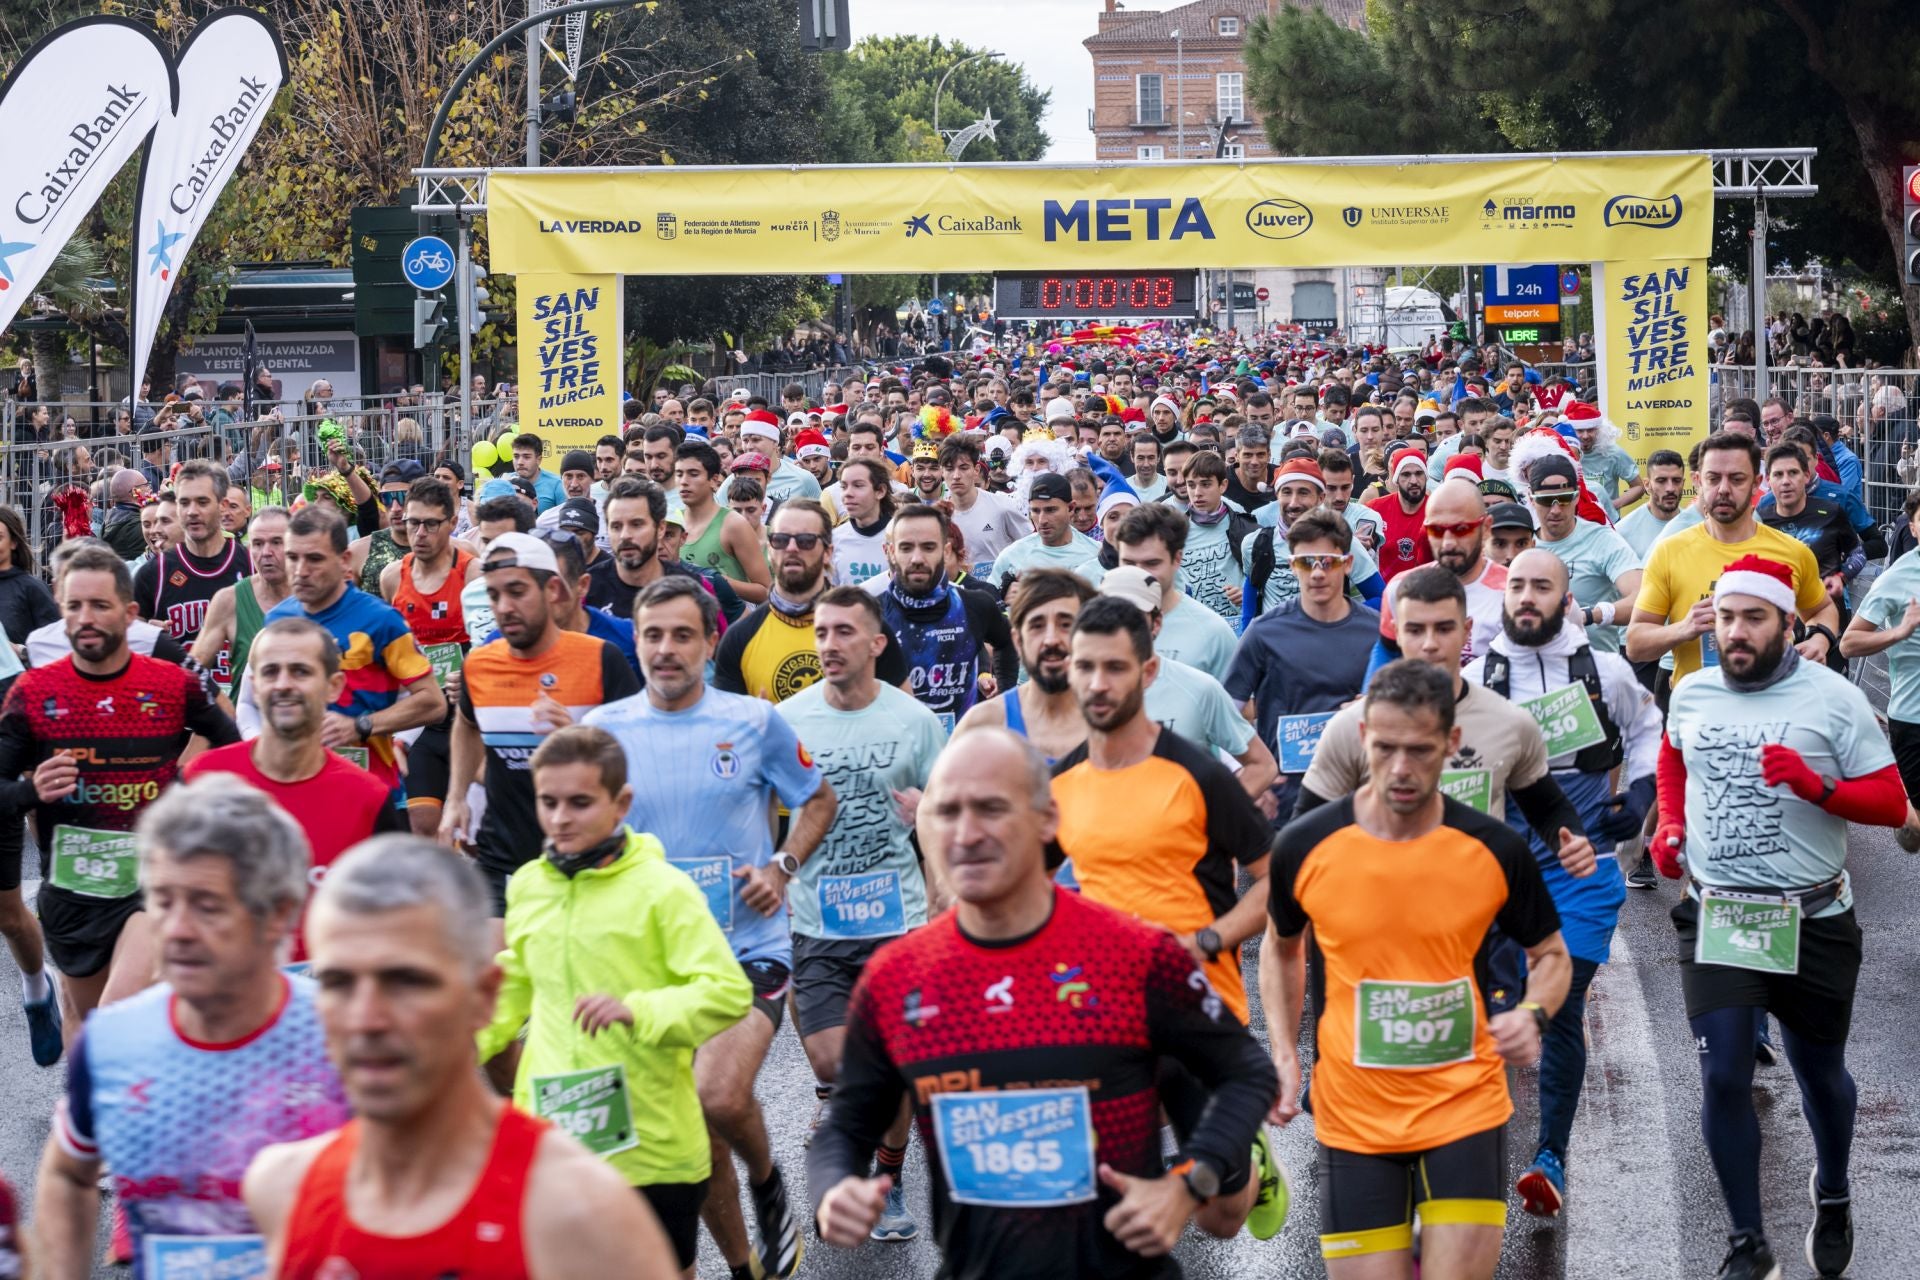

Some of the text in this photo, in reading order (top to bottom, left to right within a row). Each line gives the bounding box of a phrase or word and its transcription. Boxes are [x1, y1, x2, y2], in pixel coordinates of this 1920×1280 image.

[15, 83, 141, 224] CaixaBank
[170, 75, 267, 215] CaixaBank
[938, 215, 1022, 231] CaixaBank
[1044, 197, 1216, 242] META
[1253, 212, 1306, 227] Juver
[1371, 206, 1449, 218] UNIVERSAE
[1400, 218, 1428, 226] Superior
[1503, 205, 1575, 220] marmo
[1615, 205, 1672, 220] VIDAL
[540, 220, 641, 233] LA VERDAD
[701, 228, 723, 236] Región
[844, 220, 893, 228] Ayuntamiento
[1043, 277, 1173, 308] 0:00:08
[1516, 284, 1542, 296] 24h
[1622, 266, 1689, 301] SAN
[533, 287, 600, 321] SAN
[1503, 309, 1540, 319] telpark
[1632, 293, 1680, 325] SIL
[544, 314, 590, 344] SIL
[1505, 330, 1538, 341] LIBRE
[1625, 315, 1688, 349] VES
[275, 345, 336, 355] AVANZADA
[538, 335, 598, 368] VES
[1626, 342, 1690, 375] TRE
[204, 360, 211, 369] Y
[268, 359, 312, 369] DENTAL
[538, 361, 600, 393] TRE
[1627, 365, 1694, 391] MURCIA
[539, 384, 605, 409] MURCIA
[1627, 399, 1692, 409] LA VERDAD
[538, 418, 603, 427] LA VERDAD
[850, 562, 882, 577] SAN
[426, 645, 456, 659] ESTRE
[1536, 688, 1580, 722] VESTRE
[1285, 718, 1309, 733] SAN
[1285, 721, 1327, 743] SILVES
[64, 777, 159, 811] deagro
[825, 879, 851, 894] SAN
[825, 874, 894, 907] SILVESTRE
[836, 901, 885, 921] 1180
[1711, 907, 1792, 929] SILVESTRE
[1713, 904, 1745, 917] SAN
[1758, 919, 1790, 930] MURCIA
[1728, 929, 1772, 951] 431
[1368, 984, 1466, 1020] SILVESTRE
[1370, 988, 1410, 1004] SAN
[1380, 1018, 1455, 1044] 1907
[952, 1100, 999, 1124] SAN
[952, 1097, 1074, 1146] SILVESTRE
[967, 1140, 1062, 1174] 1865
